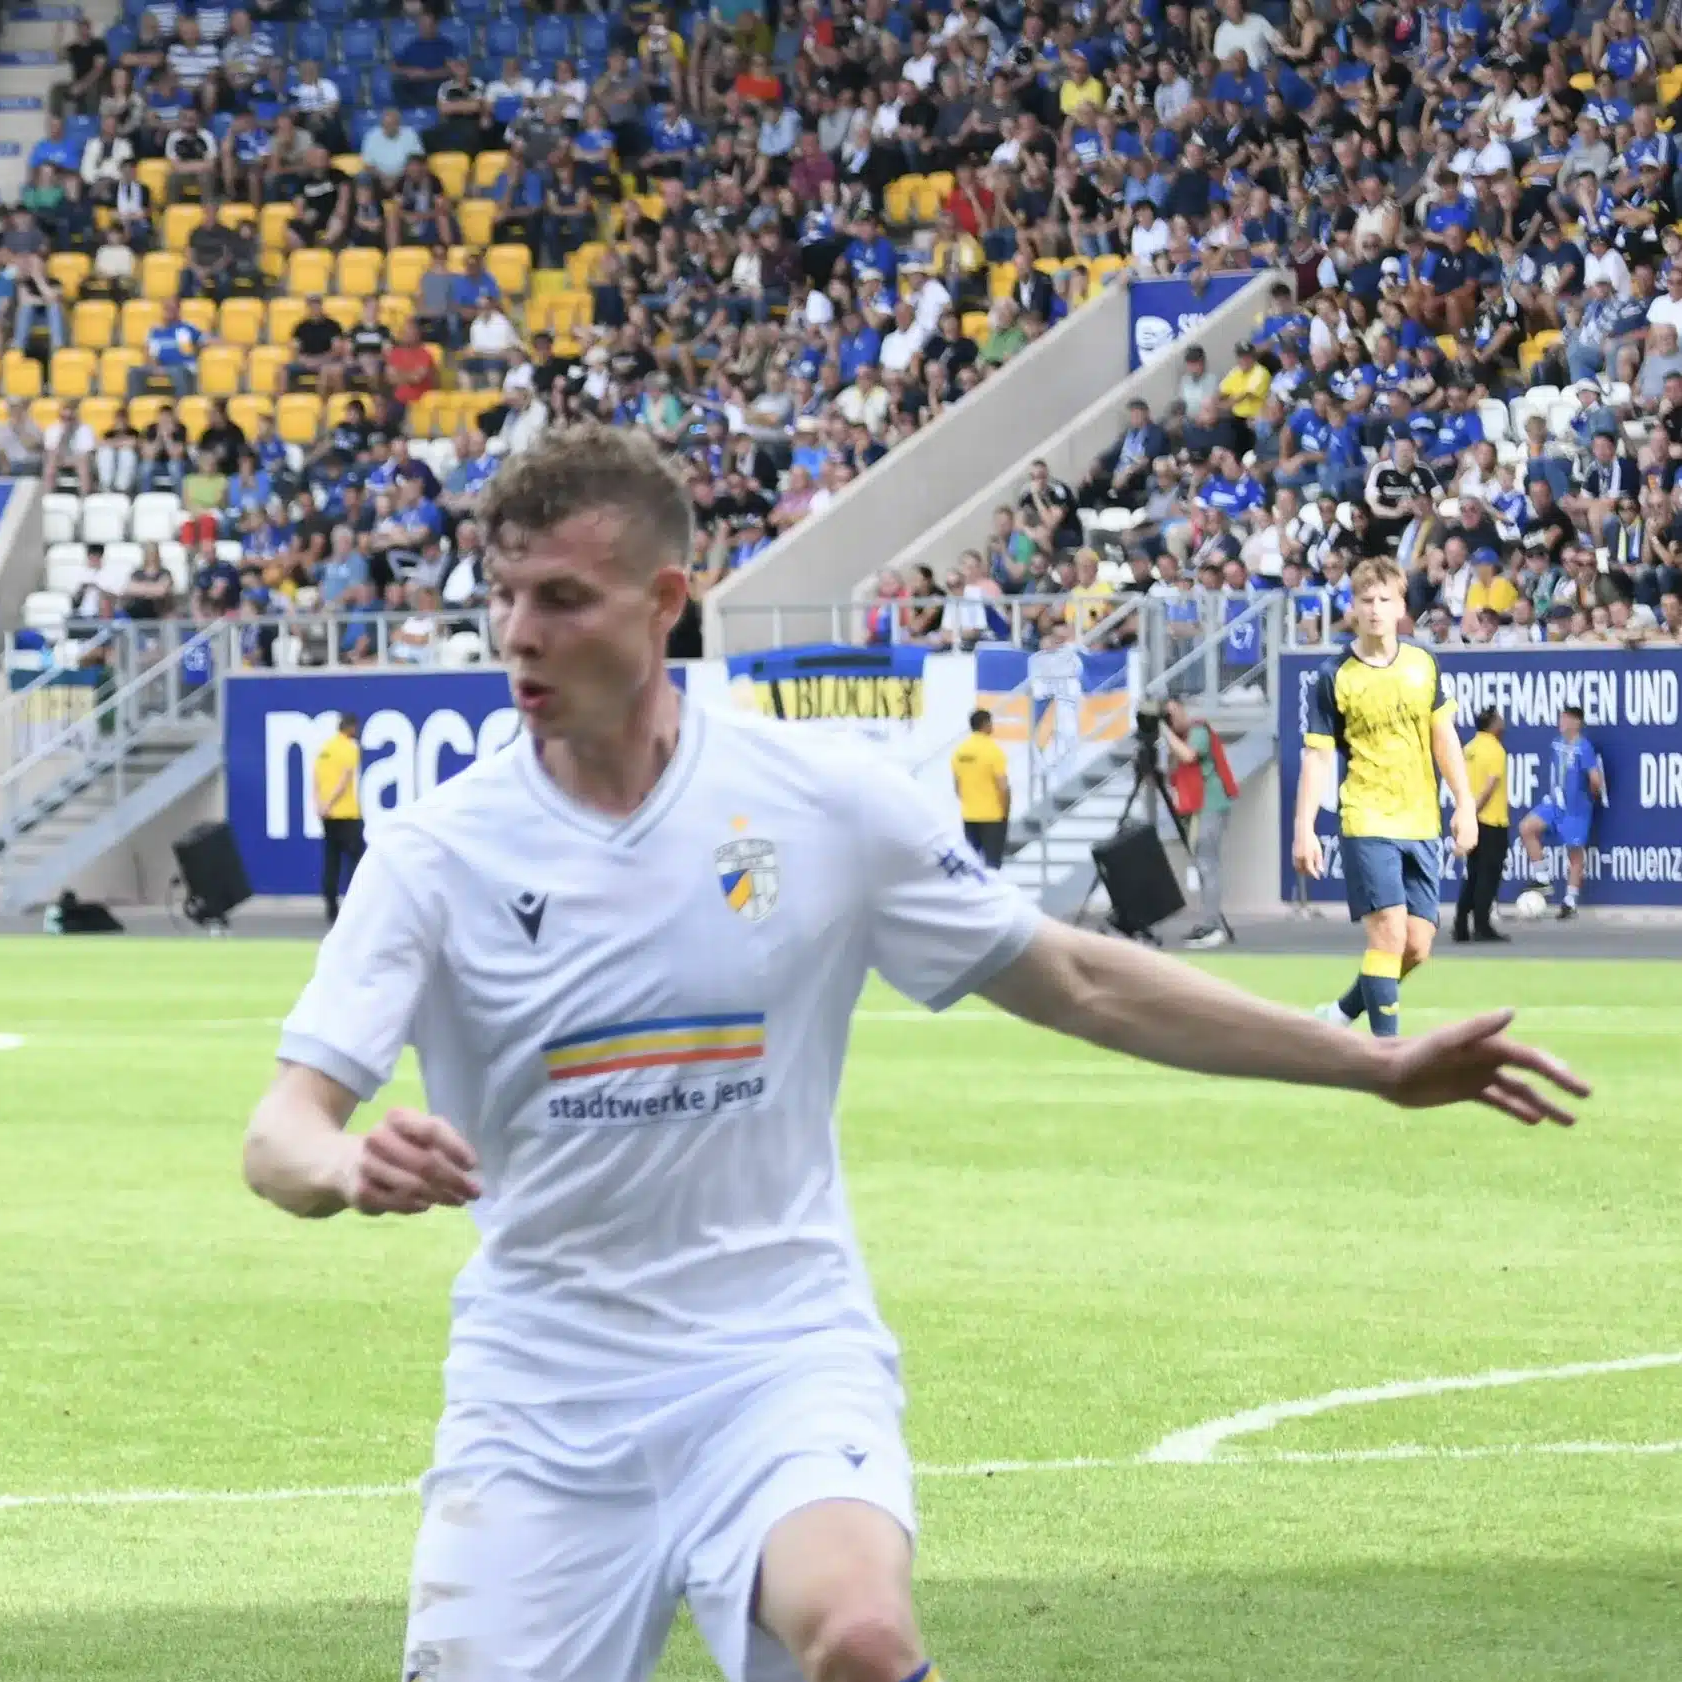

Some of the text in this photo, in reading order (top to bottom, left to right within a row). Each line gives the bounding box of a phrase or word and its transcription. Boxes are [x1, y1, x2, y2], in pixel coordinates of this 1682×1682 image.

[1624, 669, 1678, 727] UND
[266, 708, 519, 839] mac
[548, 1076, 764, 1119] stadtwerke jena
